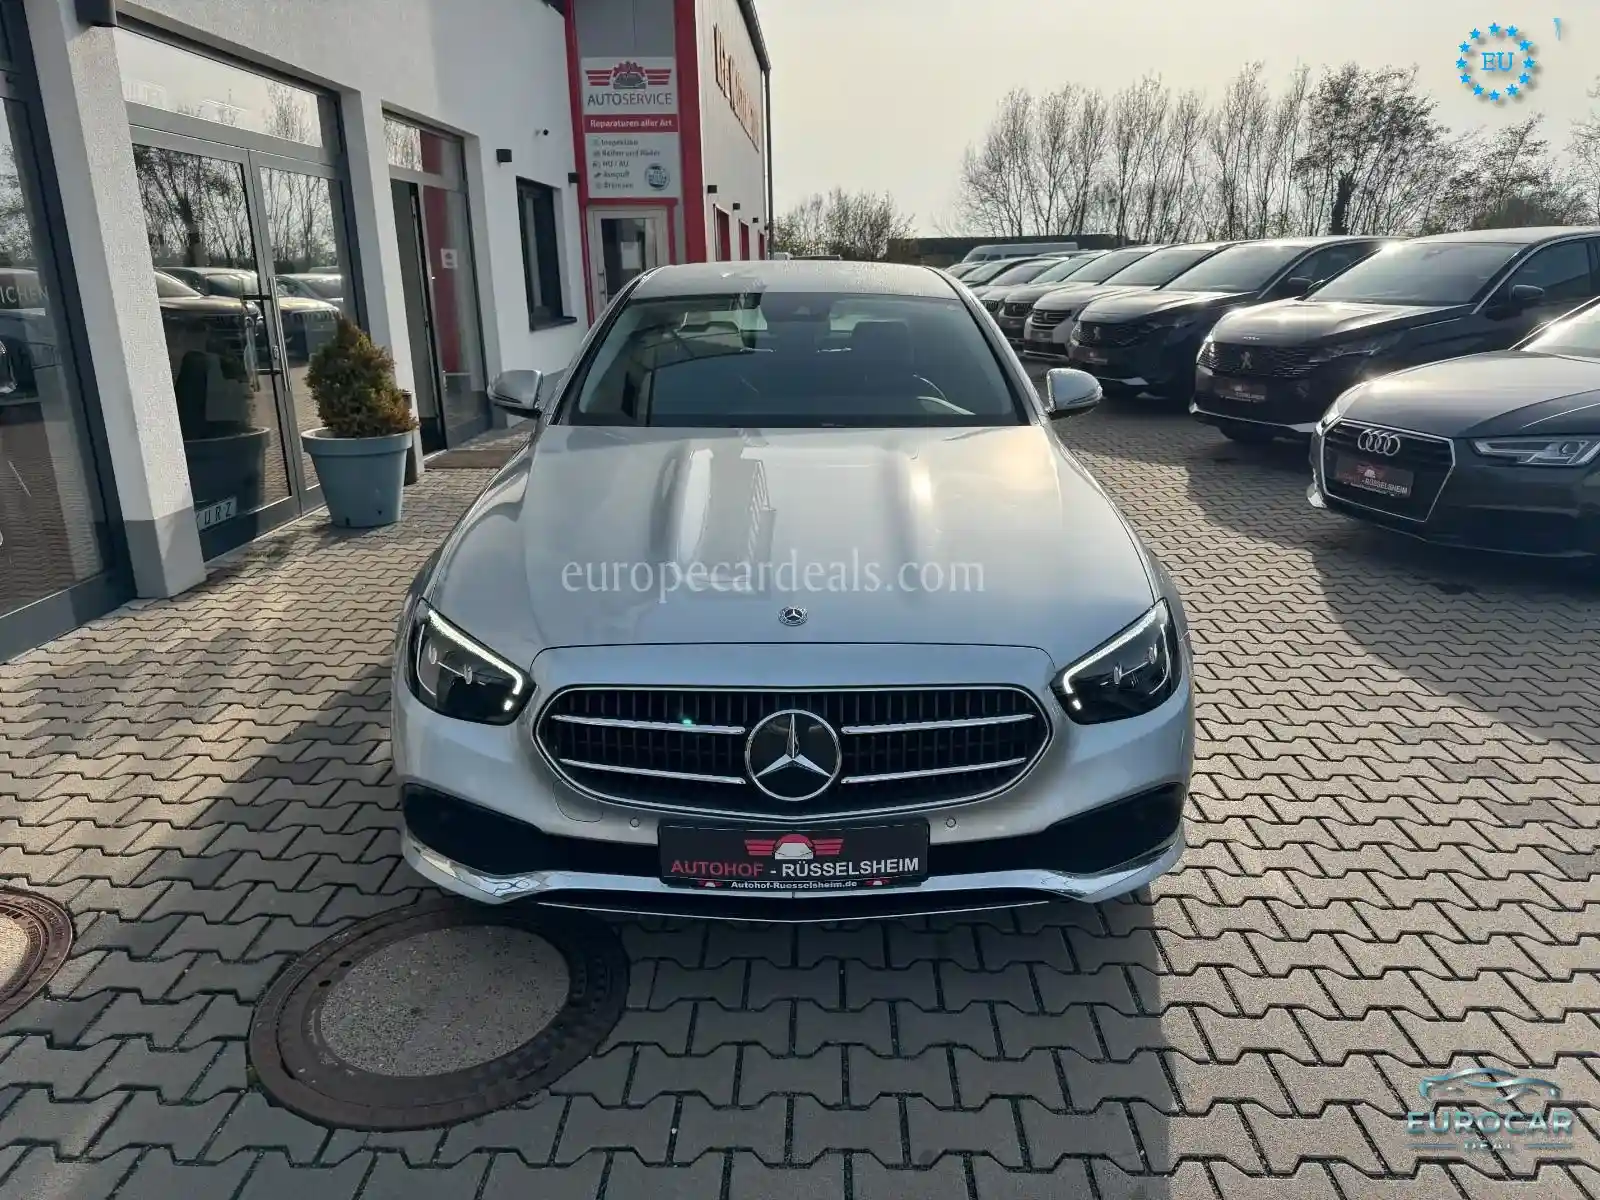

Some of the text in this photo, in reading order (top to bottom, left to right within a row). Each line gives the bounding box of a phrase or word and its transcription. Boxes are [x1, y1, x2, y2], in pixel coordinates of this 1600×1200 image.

[587, 92, 673, 107] AUTOSERVICE
[590, 119, 673, 129] Reparaturen aller Art
[671, 859, 764, 877] AUTOHOF
[781, 857, 919, 877] RÜSSELSHEIM
[731, 879, 858, 889] Autohof-Ruesselsheim.de
